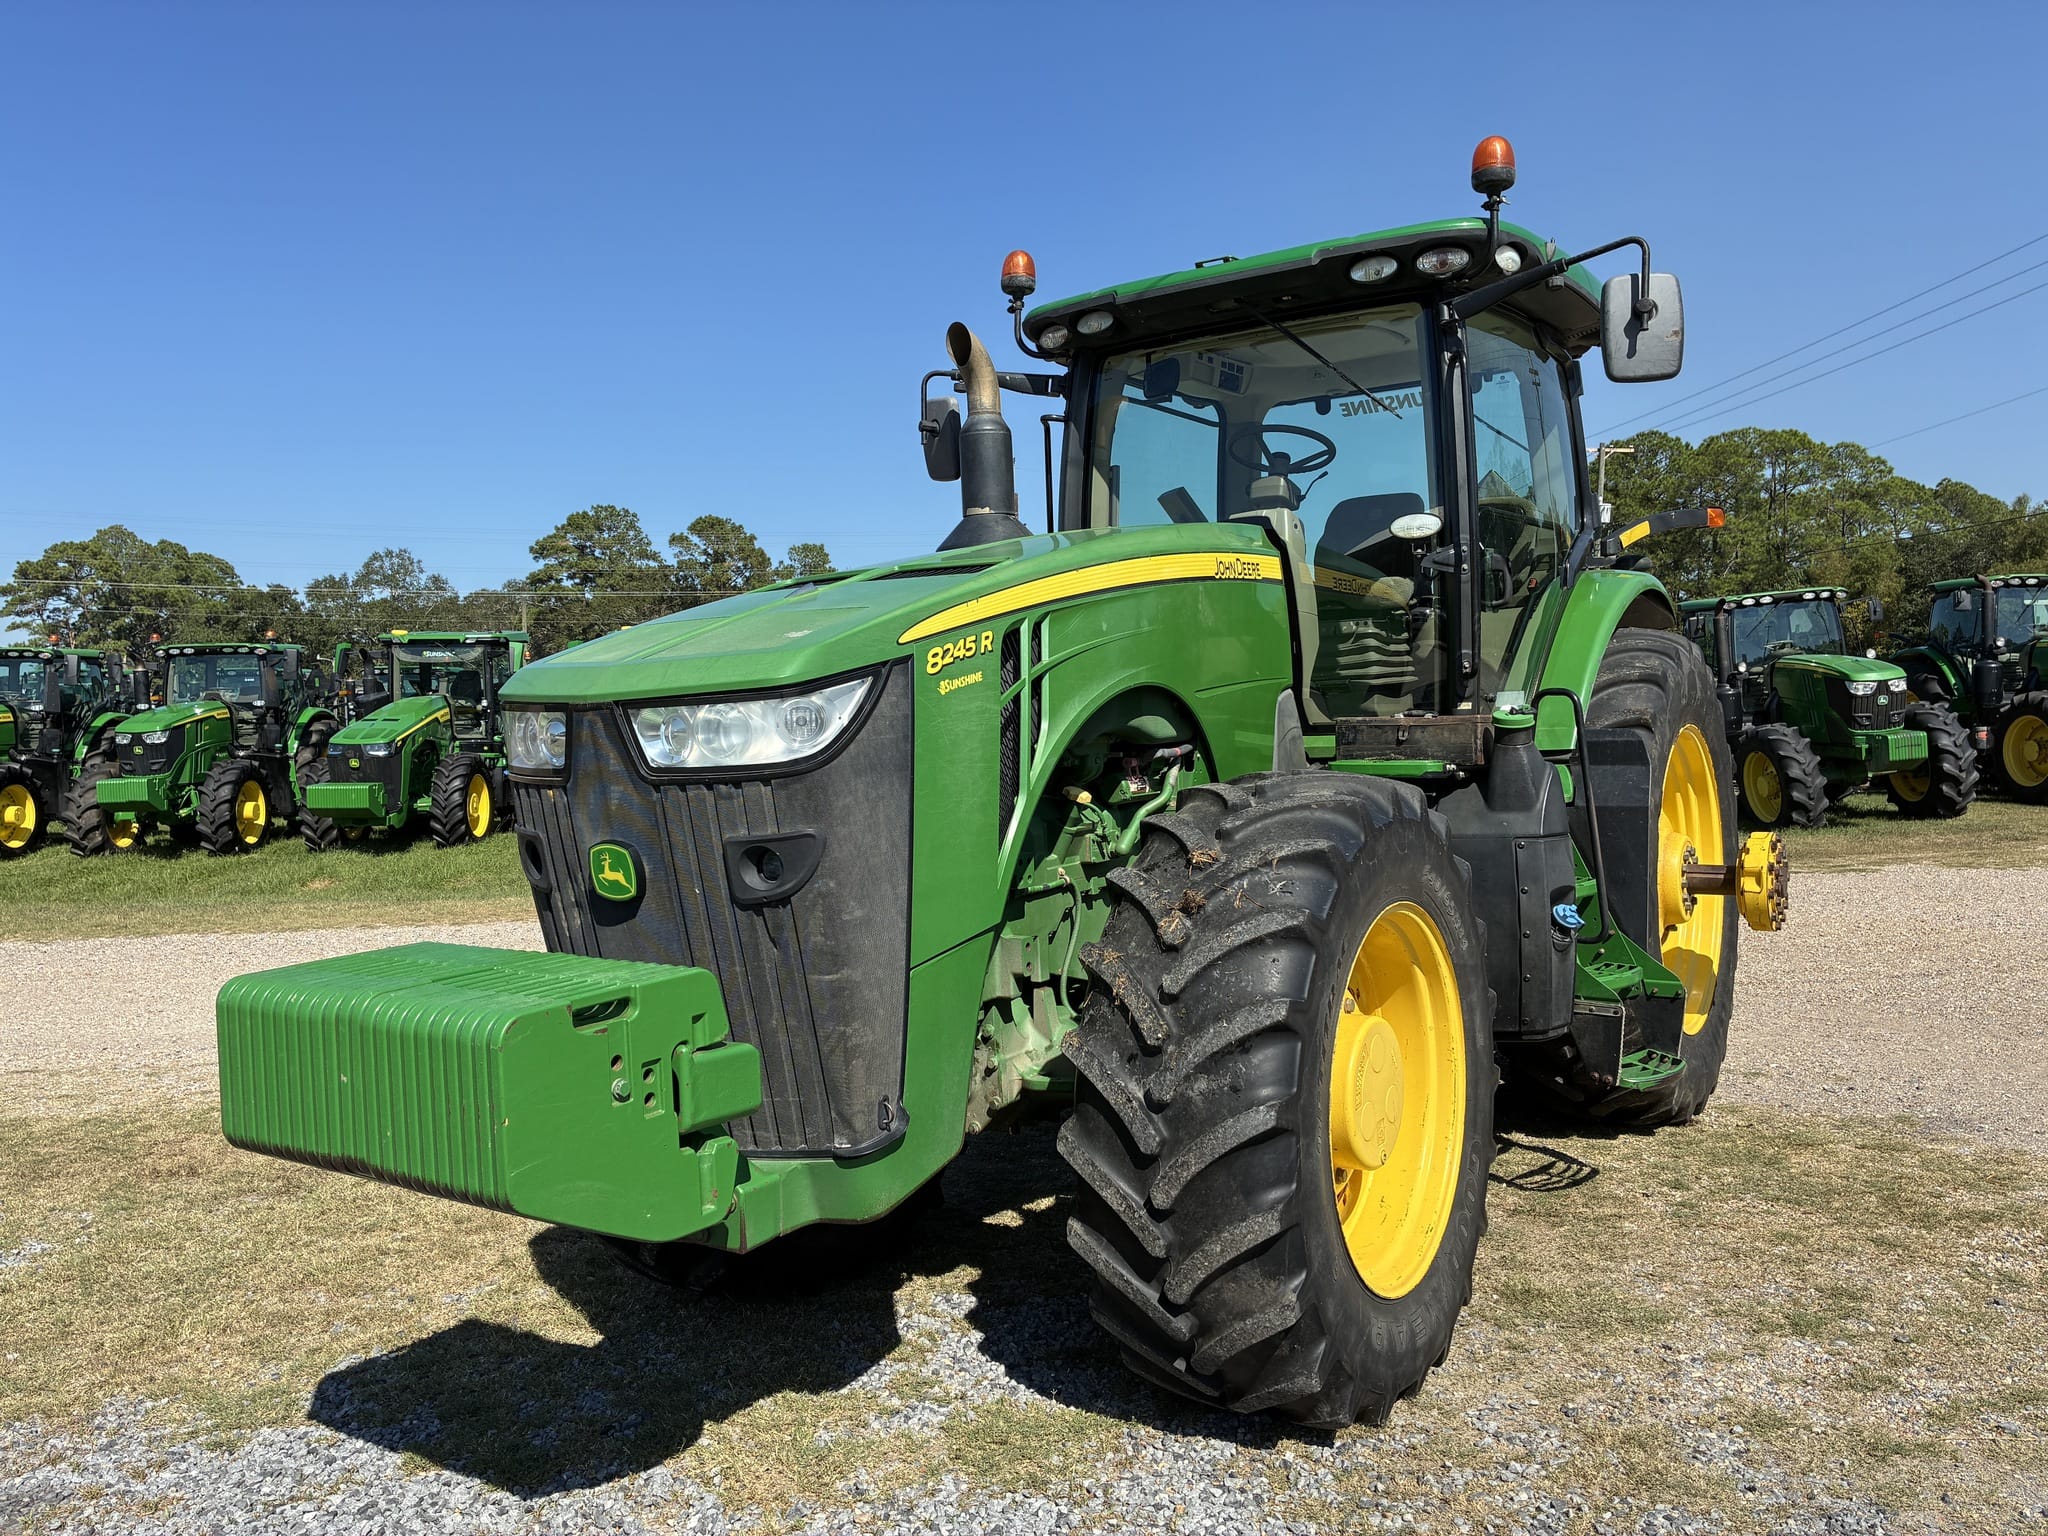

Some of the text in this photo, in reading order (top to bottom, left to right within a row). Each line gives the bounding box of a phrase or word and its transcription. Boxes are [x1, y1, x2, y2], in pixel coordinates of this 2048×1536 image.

[1214, 556, 1261, 577] JOHN DEERE
[926, 630, 994, 675] 8245 R
[943, 671, 983, 693] SUNSHINE
